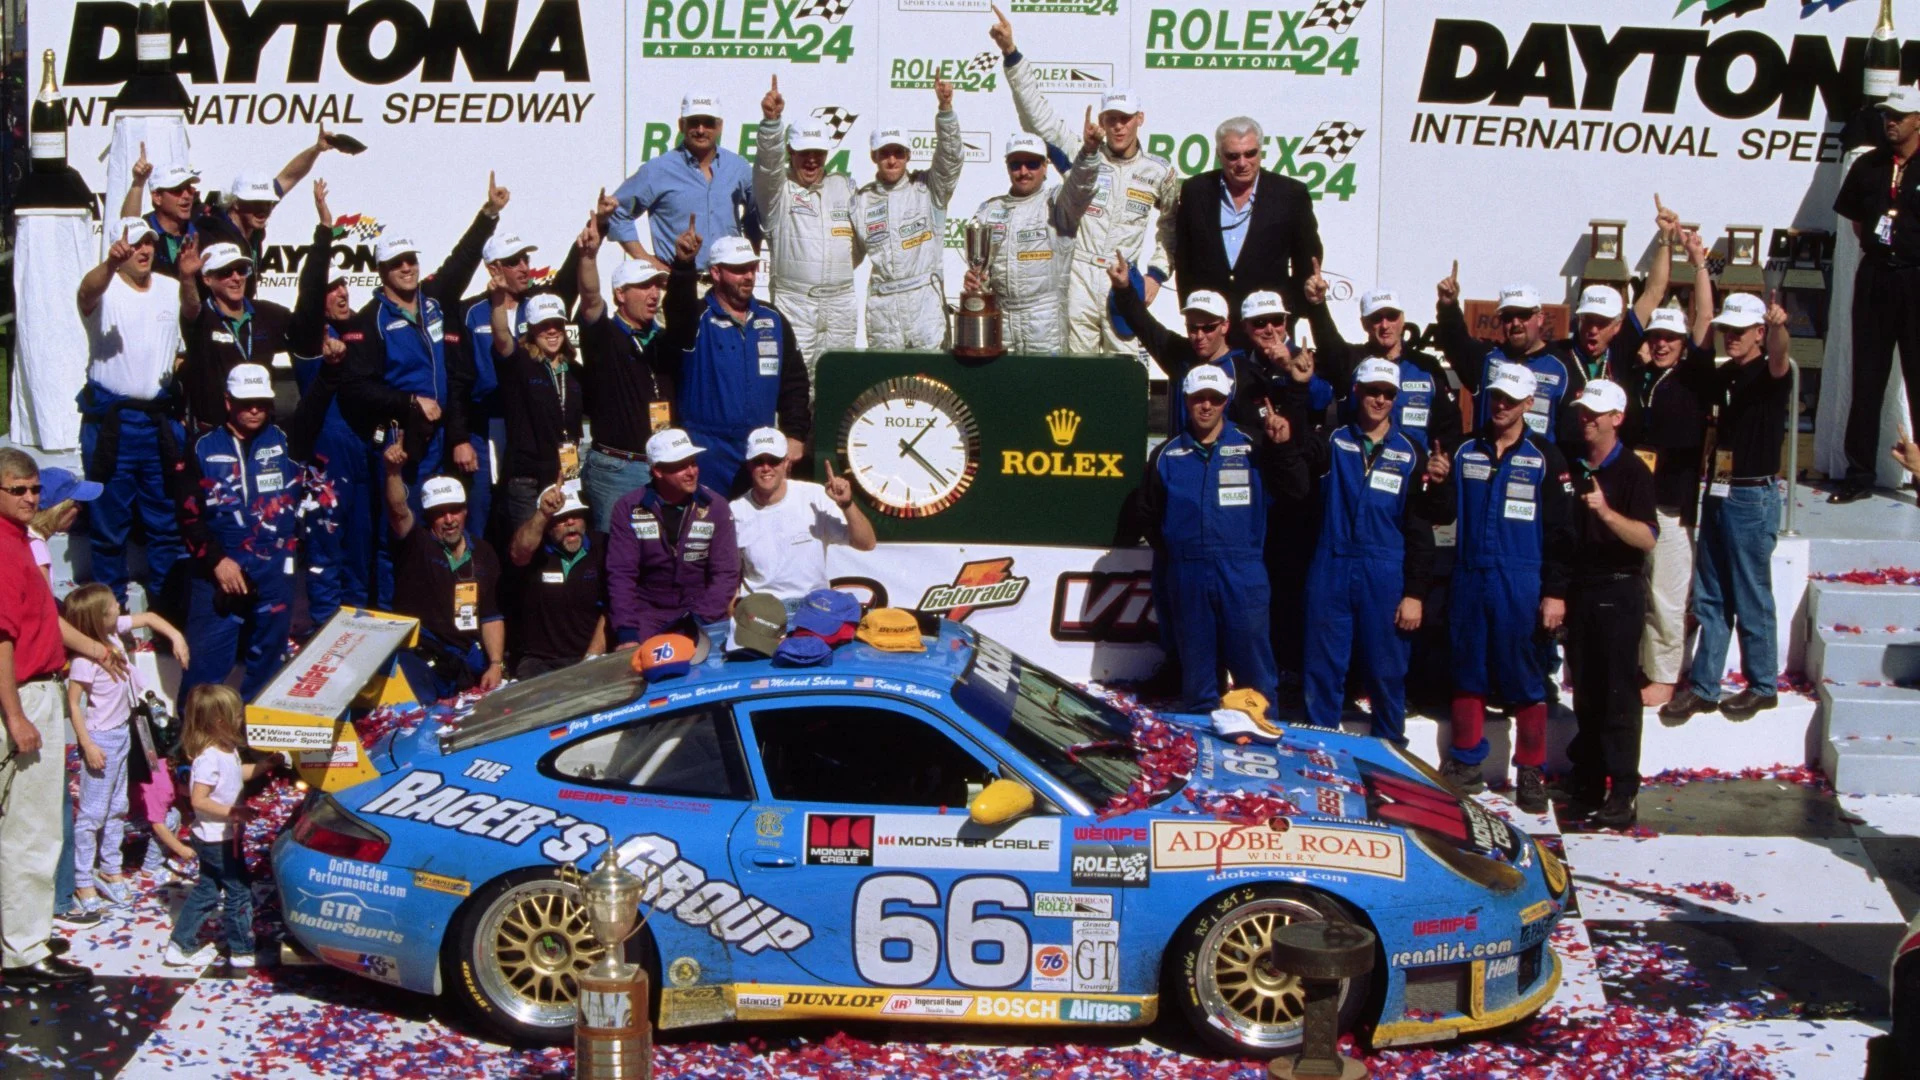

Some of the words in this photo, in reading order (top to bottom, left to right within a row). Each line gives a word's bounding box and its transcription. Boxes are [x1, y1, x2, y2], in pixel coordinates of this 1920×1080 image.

[62, 0, 590, 85] DAYTONA
[643, 0, 797, 40] ROLEX
[791, 24, 855, 63] 24
[1146, 9, 1306, 51] ROLEX
[1295, 36, 1360, 75] 24
[654, 44, 679, 56] AT
[691, 44, 788, 57] DAYTONA
[1156, 56, 1181, 67] AT
[1195, 56, 1292, 69] DAYTONA
[1417, 18, 1920, 122] DAYTON
[891, 59, 970, 80] ROLEX
[965, 73, 997, 92] 24
[1033, 69, 1068, 80] OLEX
[382, 92, 595, 124] SPEEDWAY
[1410, 113, 1719, 157] INTERNATIONAL
[884, 417, 935, 428] ROLEX
[1001, 451, 1124, 477] ROLEX
[925, 577, 1029, 610] Gatorade
[878, 625, 918, 633] DUNLOP
[652, 641, 675, 661] 76
[770, 678, 811, 688] Michael
[267, 729, 291, 737] Wine
[294, 730, 333, 740] Country
[300, 737, 333, 745] Sports
[462, 757, 513, 784] THE
[558, 788, 629, 806] WEMPE
[360, 769, 612, 864] RACER'S
[898, 836, 988, 848] MONSTER
[993, 837, 1051, 850] CABLE
[1074, 827, 1148, 841] WEMPE
[1167, 830, 1283, 852] ADOBE
[1300, 834, 1392, 860] ROAD
[810, 848, 870, 857] MONSTER
[820, 855, 859, 864] CABLE
[1248, 851, 1317, 862] WINERY
[329, 858, 389, 882] OnTheEdge
[1073, 855, 1129, 873] ROLEX
[1122, 865, 1148, 881] 24
[1206, 869, 1349, 884] adobe-road.com
[309, 868, 407, 898] Performance.com
[593, 832, 814, 956] GROUP
[320, 900, 363, 922] GTR
[1037, 901, 1073, 912] ROLEX
[289, 911, 405, 944] MotorSports
[852, 870, 1034, 990] 66
[1413, 915, 1478, 937] WEMPE
[1041, 953, 1064, 970] 76
[1076, 938, 1117, 981] GT
[1392, 938, 1513, 967] rennlist.com
[1487, 954, 1520, 980] Hella
[1079, 983, 1114, 992] Touring
[785, 991, 885, 1008] DUNLOP
[977, 996, 1057, 1019] BOSCH
[1069, 999, 1132, 1022] Airgas
